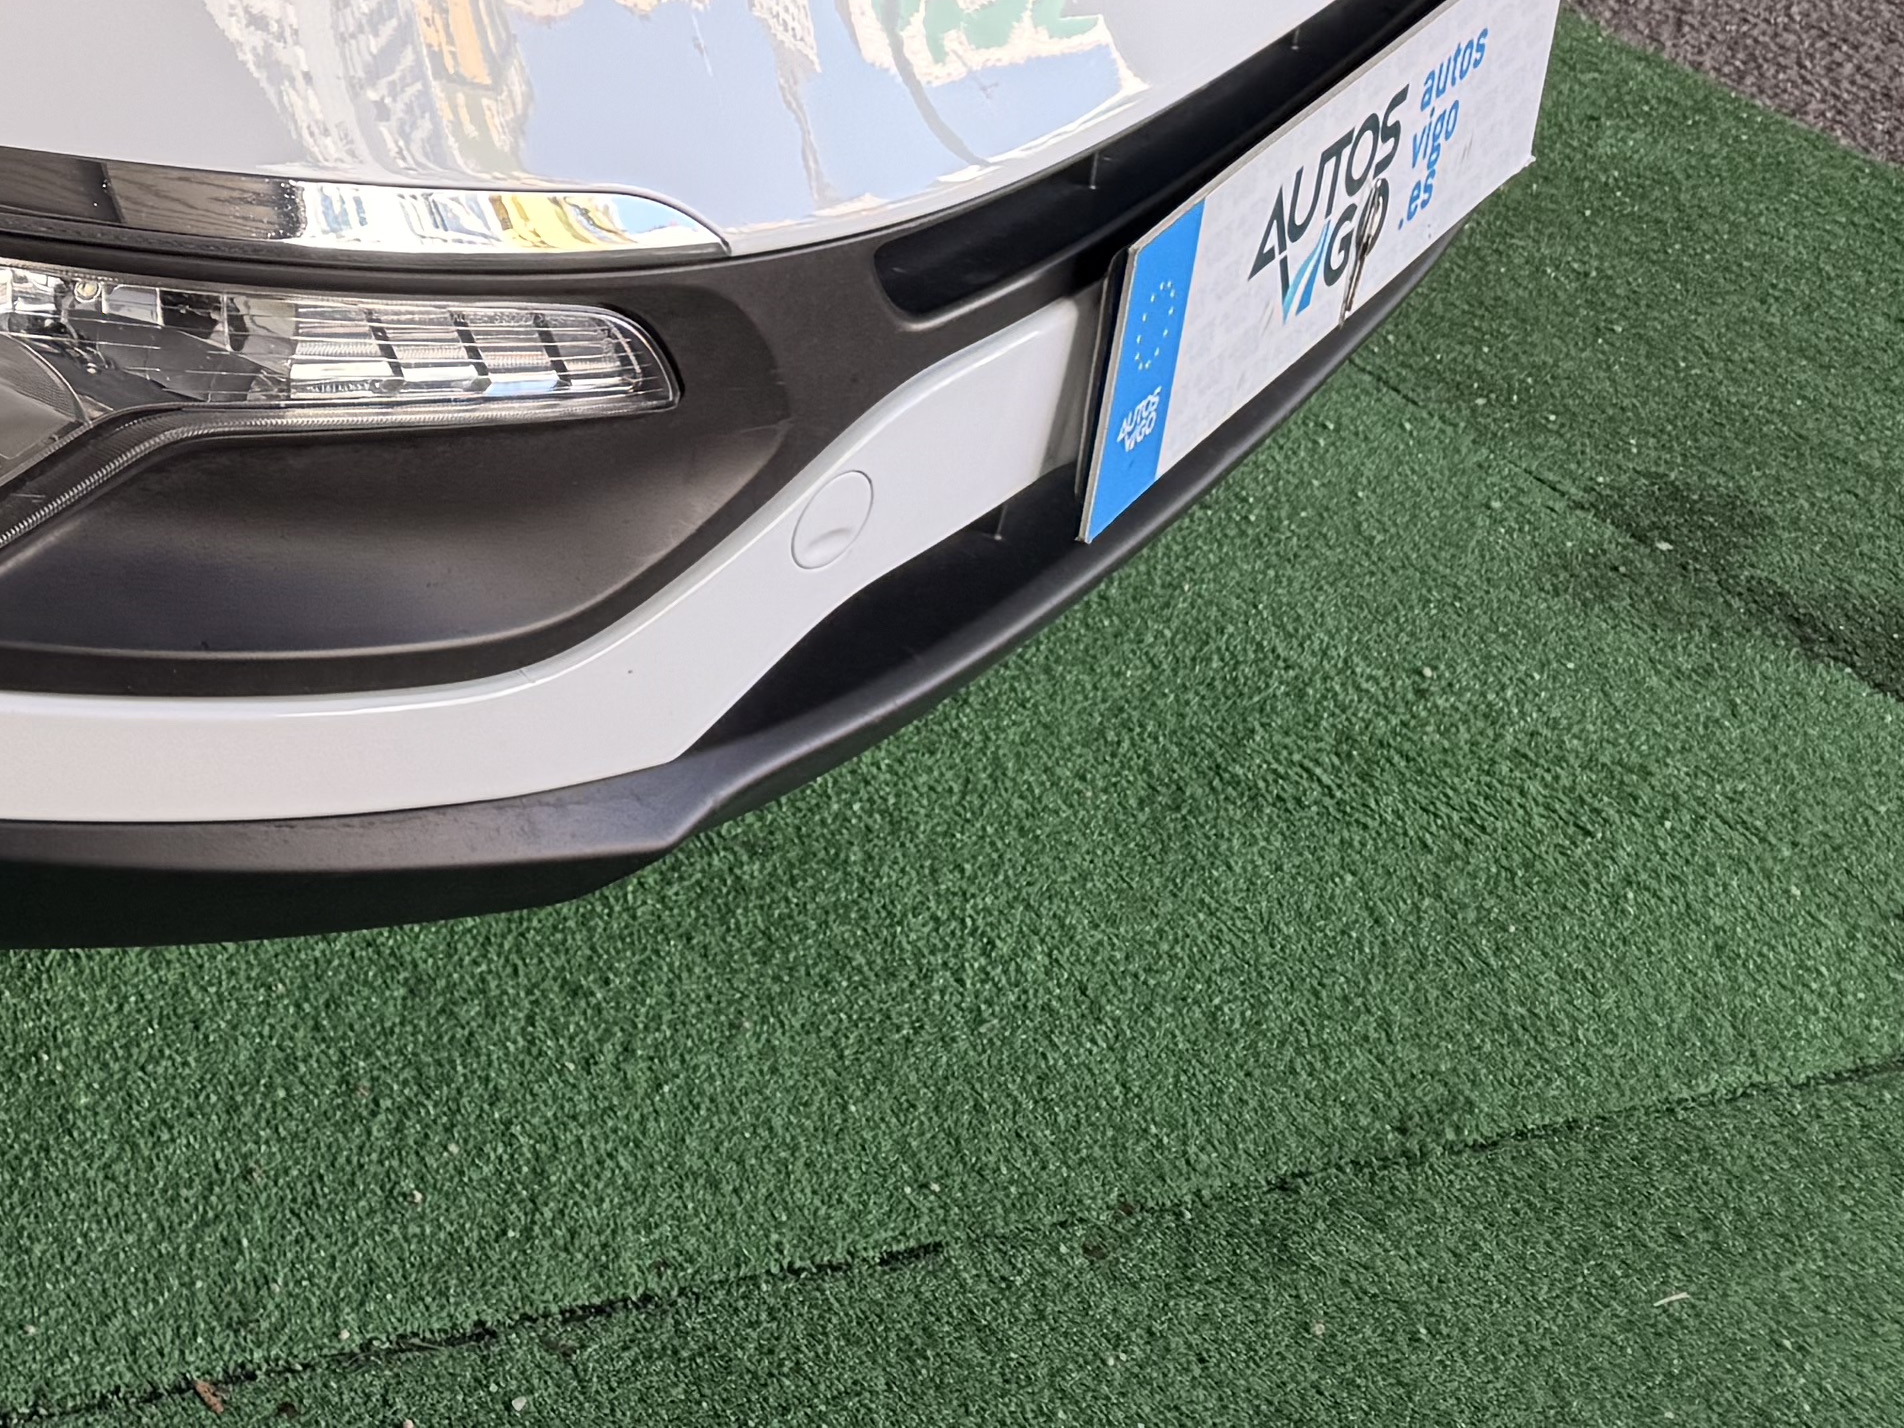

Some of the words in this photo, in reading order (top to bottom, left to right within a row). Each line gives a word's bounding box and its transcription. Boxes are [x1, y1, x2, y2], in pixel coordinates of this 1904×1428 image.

[1420, 27, 1489, 113] autos
[1411, 99, 1460, 171] vigo
[1247, 83, 1410, 282] AUTOS
[1278, 178, 1390, 326] VIGO
[1116, 385, 1163, 443] AUTOS
